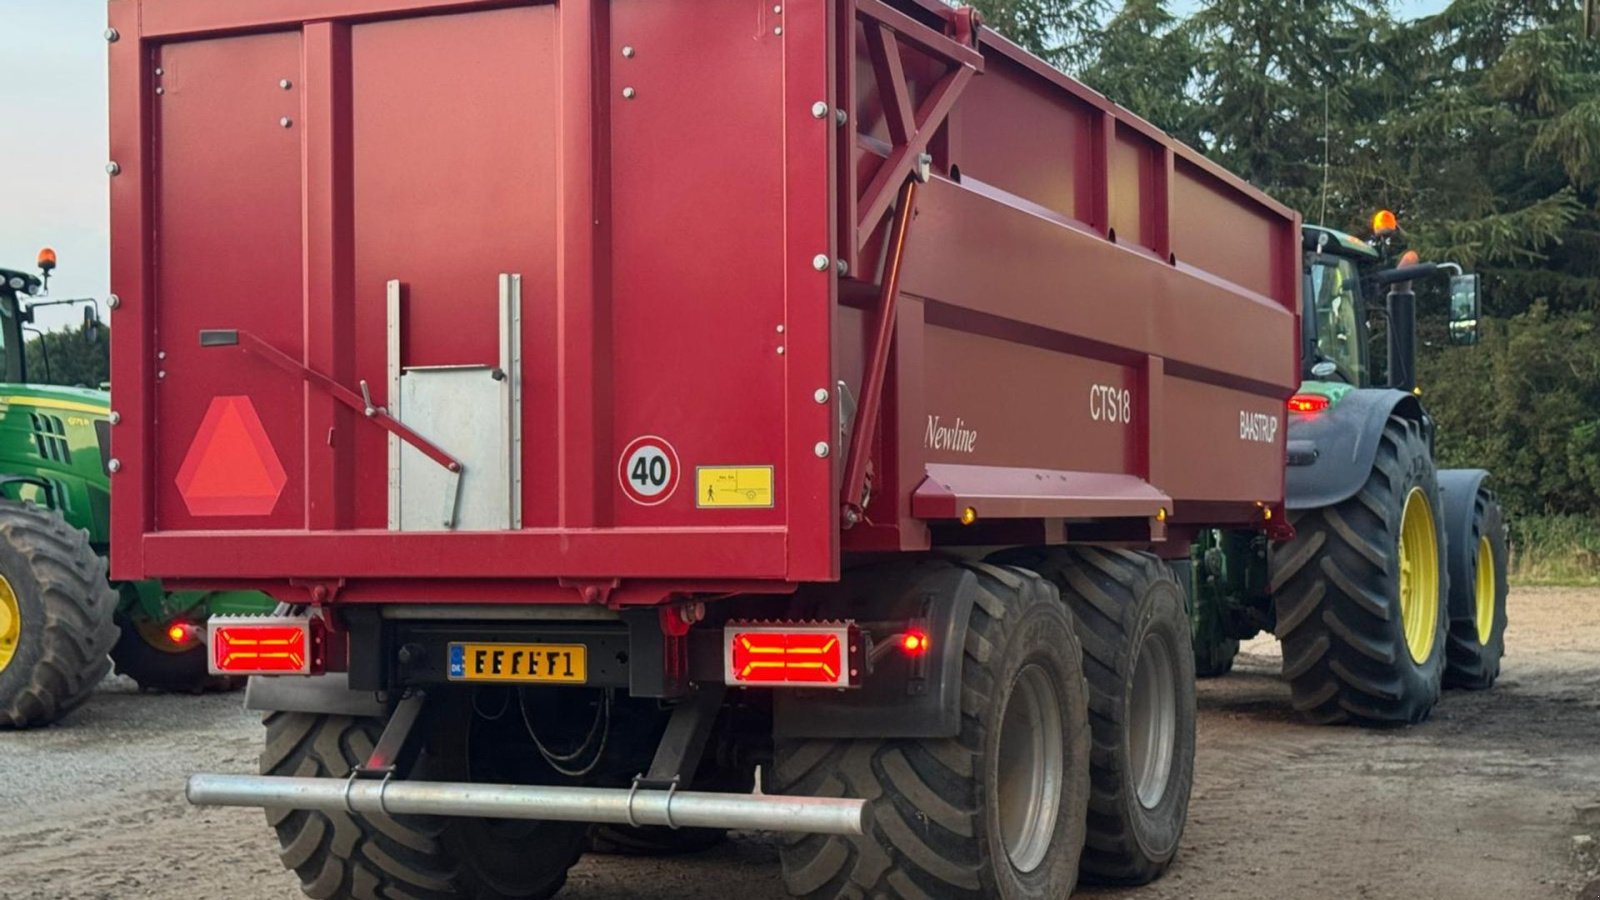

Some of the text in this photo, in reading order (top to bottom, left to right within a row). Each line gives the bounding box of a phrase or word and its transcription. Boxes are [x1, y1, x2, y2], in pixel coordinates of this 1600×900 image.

[1090, 384, 1131, 424] CTS18
[924, 414, 977, 453] Newline
[1240, 410, 1277, 443] BAASTRUP
[631, 455, 667, 486] 40
